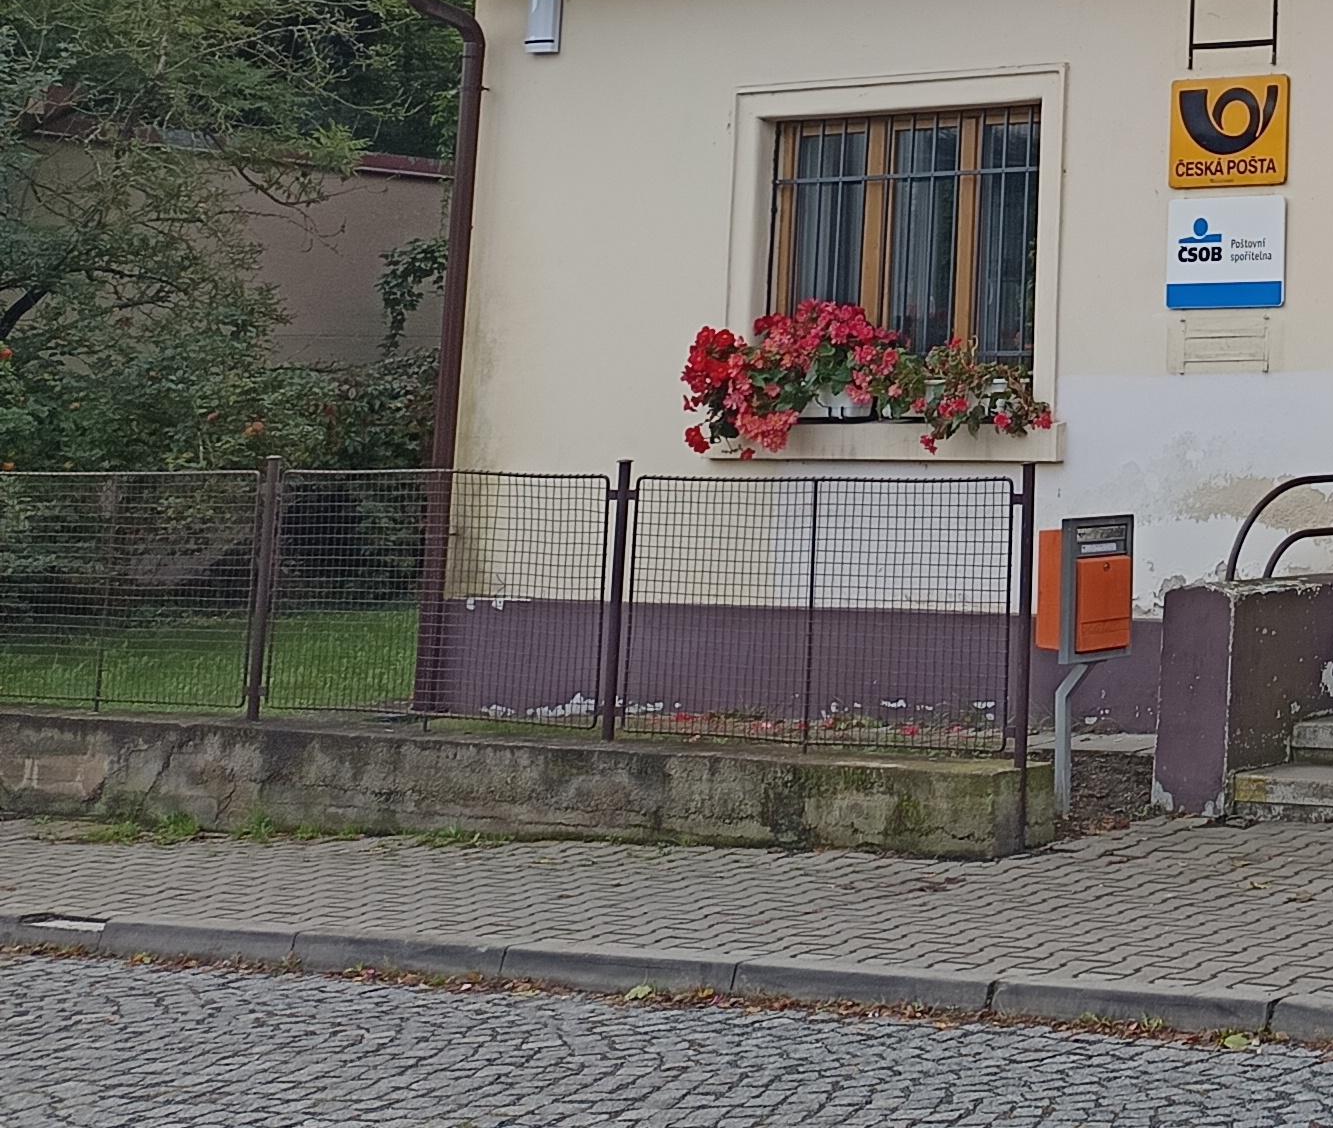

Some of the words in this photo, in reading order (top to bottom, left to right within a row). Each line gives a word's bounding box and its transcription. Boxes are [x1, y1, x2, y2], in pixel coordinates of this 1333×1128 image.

[1175, 157, 1224, 177] ČESKÁ
[1227, 155, 1277, 175] POŠTA
[1230, 238, 1266, 249] Poštovní
[1178, 246, 1222, 263] ČSOB
[1230, 252, 1272, 264] spořitelna
